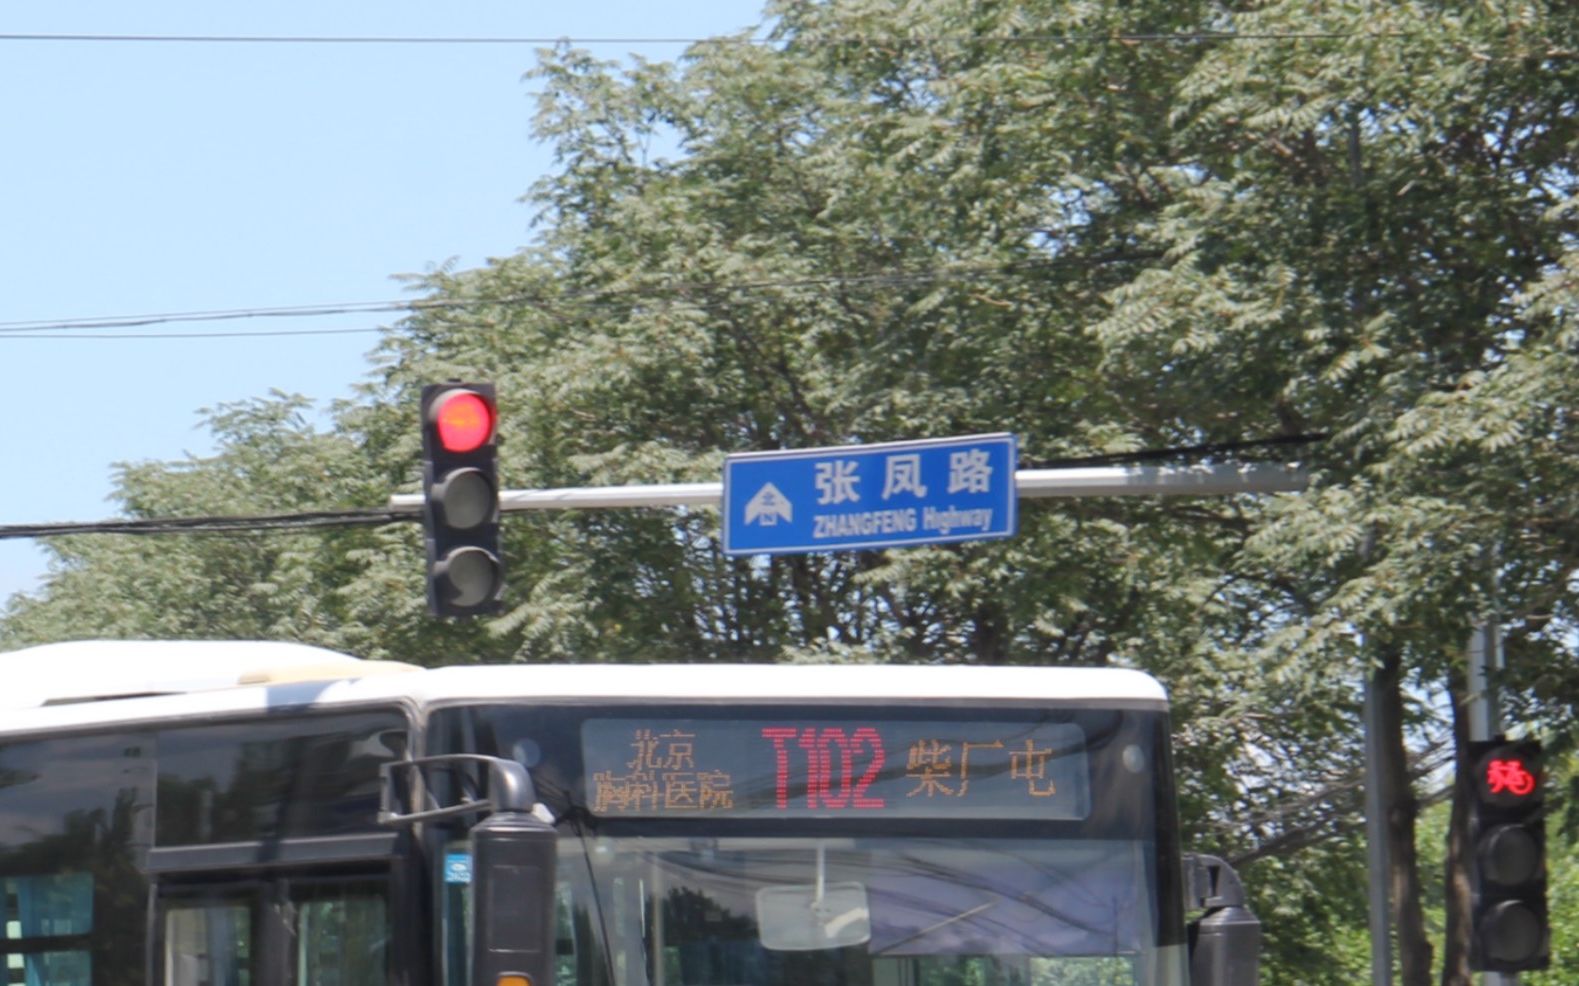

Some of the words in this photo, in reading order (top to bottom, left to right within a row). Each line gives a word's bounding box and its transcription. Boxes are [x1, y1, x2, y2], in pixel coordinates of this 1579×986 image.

[813, 449, 994, 505] 张凤路
[813, 508, 917, 539] ZHANGFENG
[923, 505, 993, 535] Highway
[626, 728, 696, 771] 北京
[761, 727, 886, 810] T102
[906, 738, 1057, 798] 柴厂屯
[592, 770, 734, 813] 胸科医院
